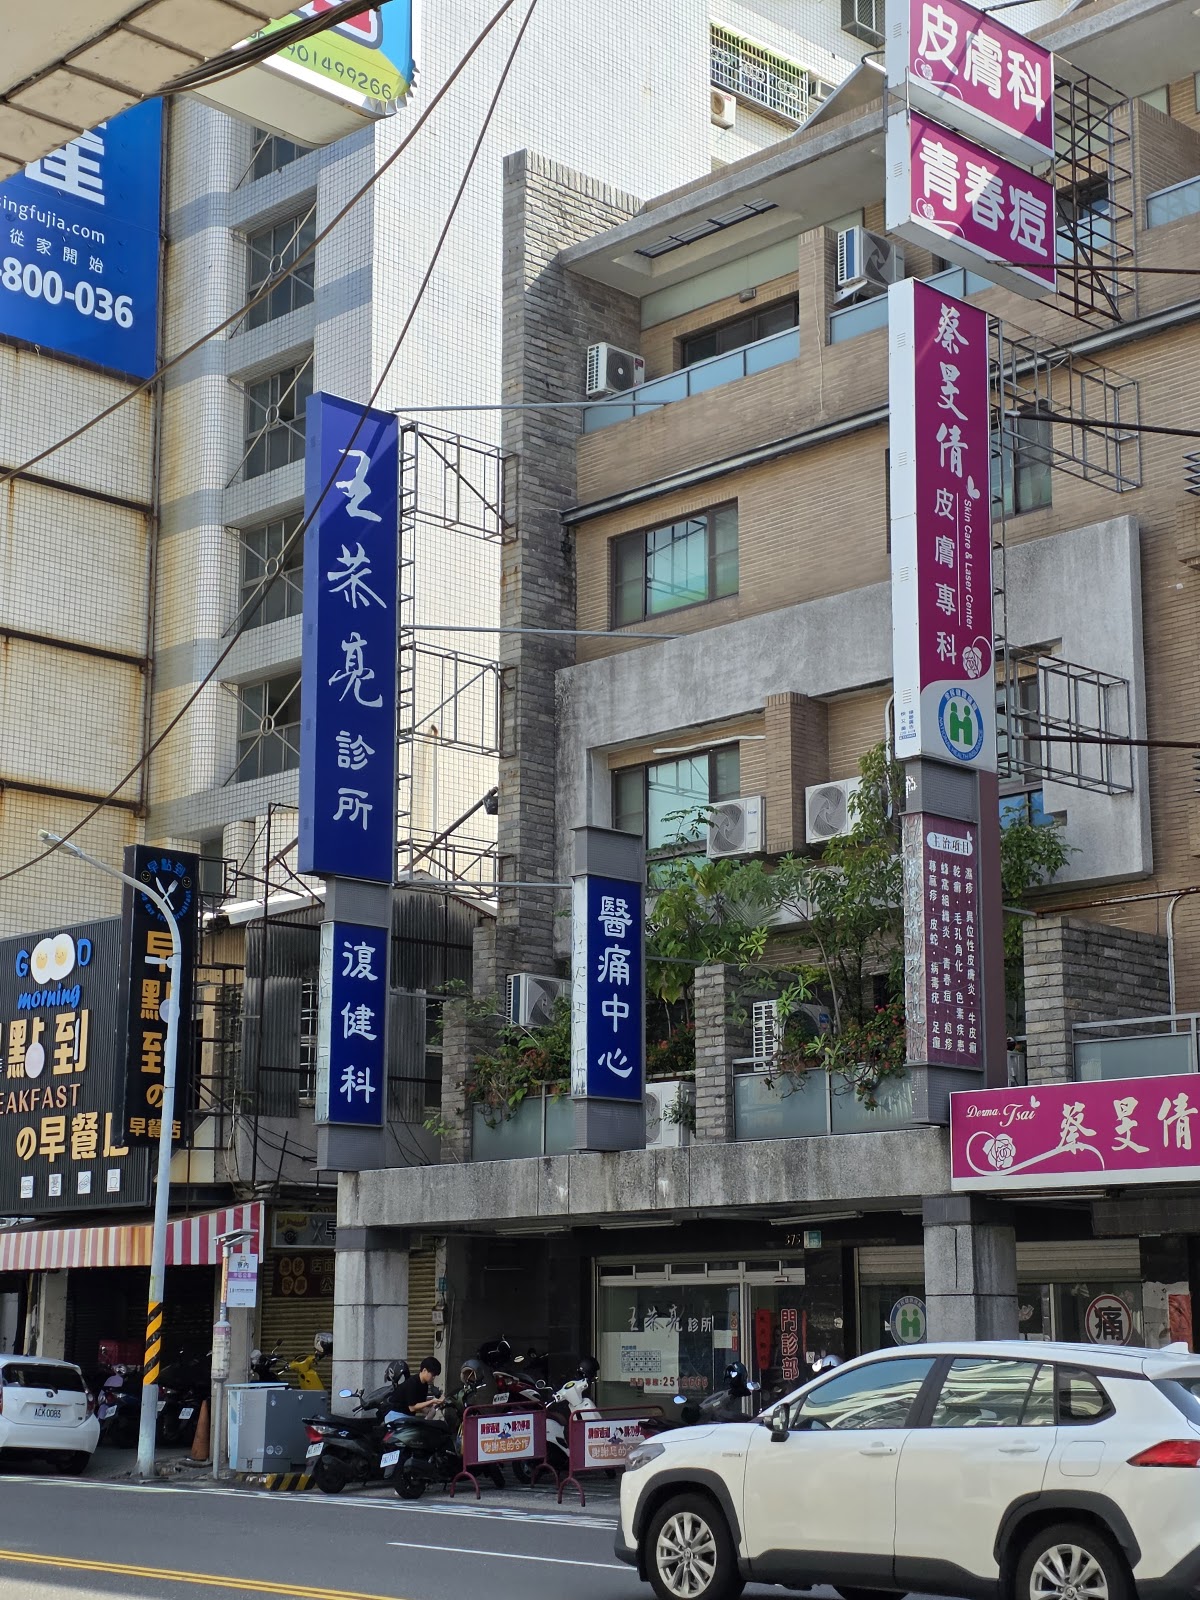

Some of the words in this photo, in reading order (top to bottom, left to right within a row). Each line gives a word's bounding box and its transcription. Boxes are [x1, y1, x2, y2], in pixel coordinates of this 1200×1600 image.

[917, 2, 1046, 123] 皮膚科
[0, 195, 105, 244] ingfujia.com
[918, 137, 1048, 258] 青春痘
[9, 228, 104, 274] 從家開始
[0, 256, 134, 328] 800-036
[963, 499, 972, 522] Skin
[964, 525, 973, 549] Care
[965, 551, 973, 559] &
[965, 562, 973, 592] Laser
[965, 594, 974, 630] Center
[932, 833, 969, 854] 主治項目
[17, 983, 82, 1010] morning
[597, 895, 633, 1079] 醫痛中心
[0, 1009, 90, 1080] 點到
[1057, 1092, 1199, 1155] 蔡旻倩
[781, 1308, 800, 1380] 門診部
